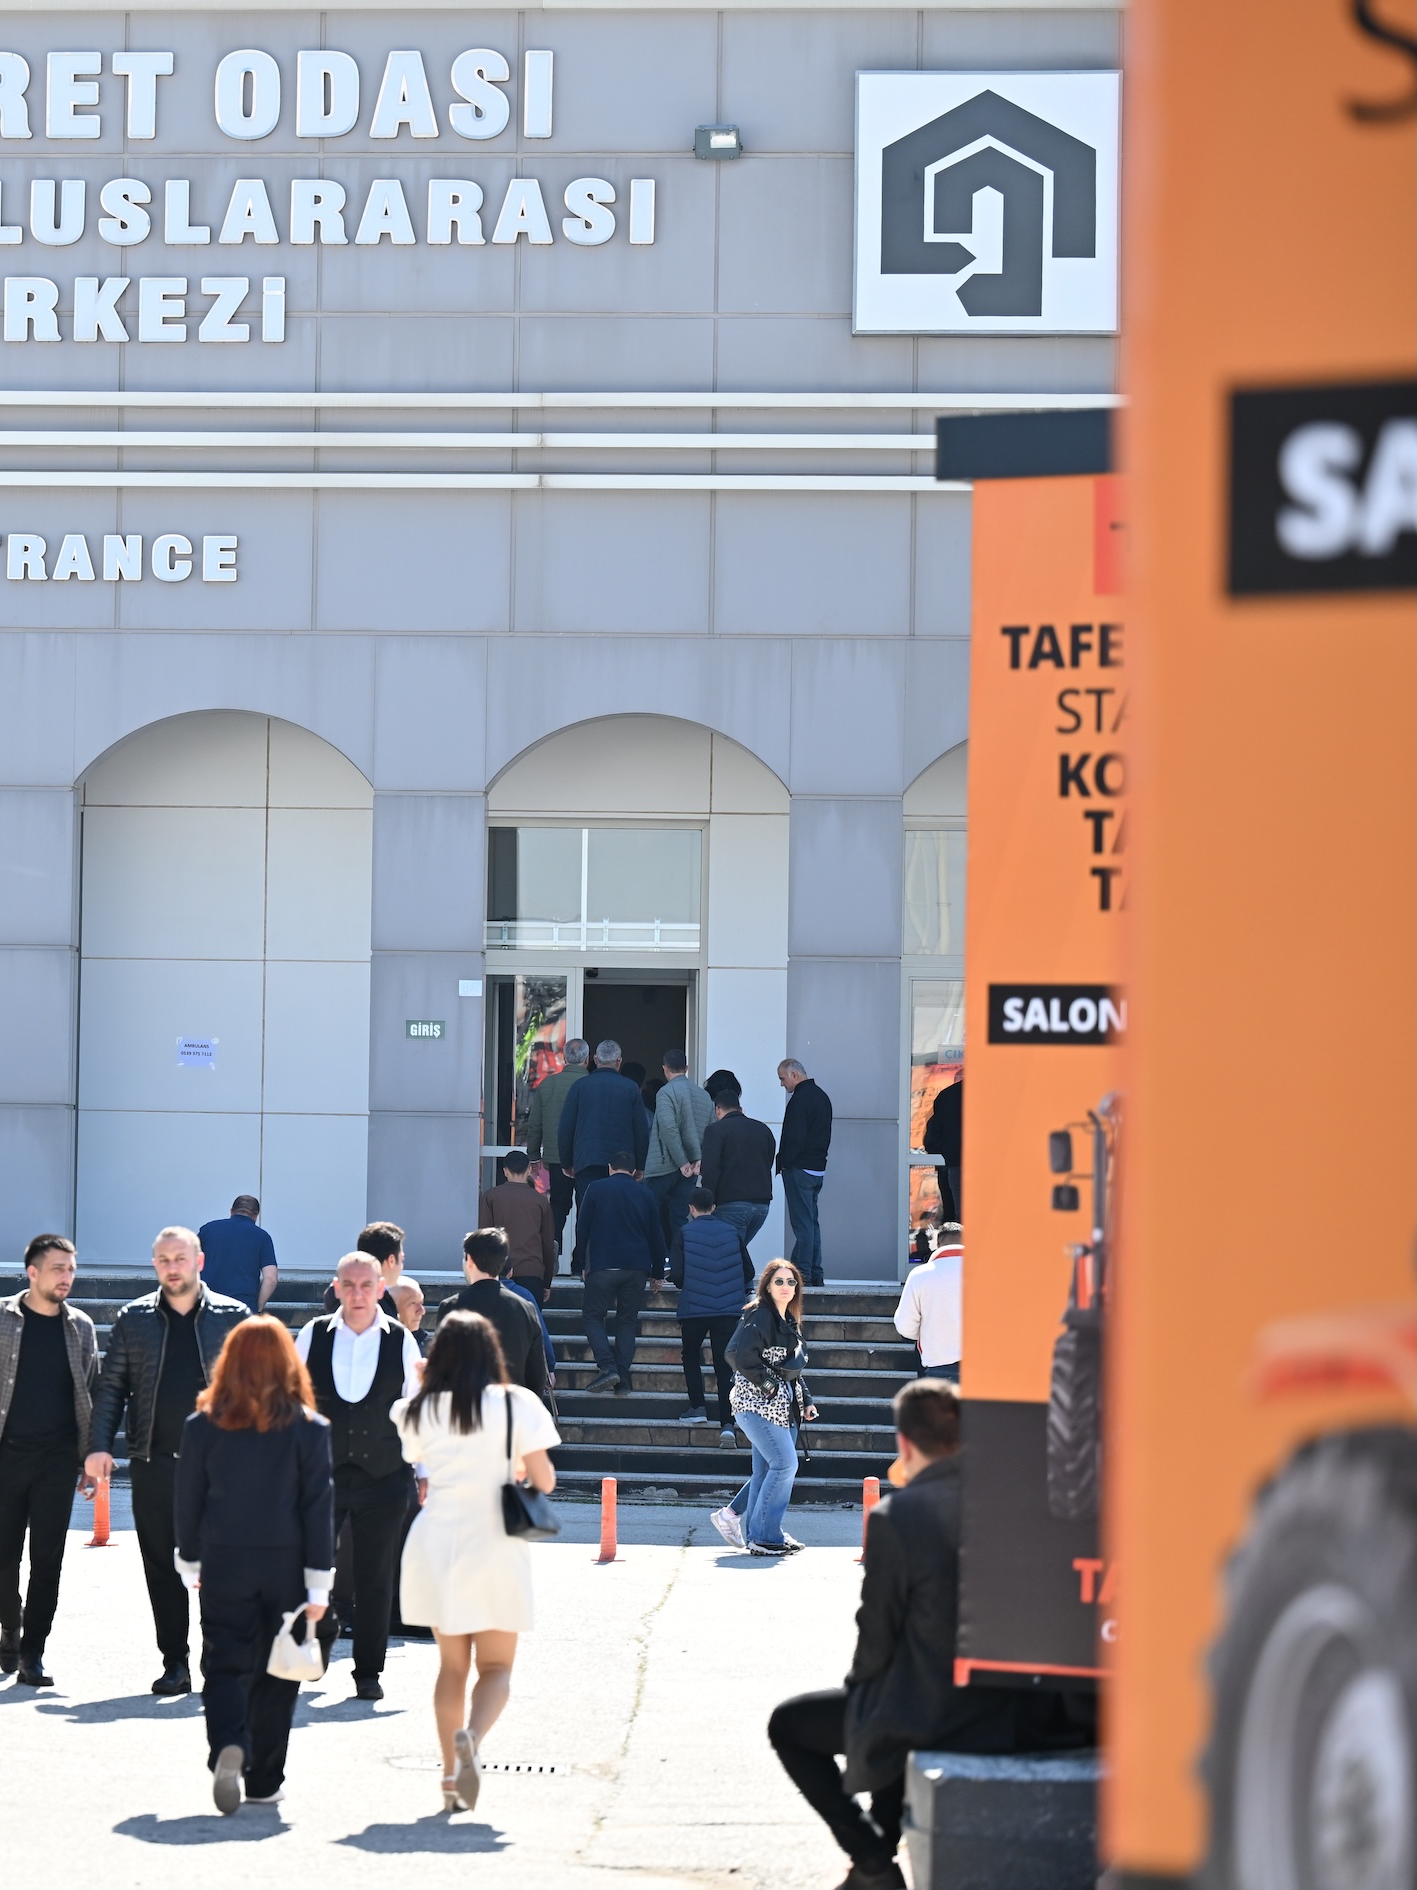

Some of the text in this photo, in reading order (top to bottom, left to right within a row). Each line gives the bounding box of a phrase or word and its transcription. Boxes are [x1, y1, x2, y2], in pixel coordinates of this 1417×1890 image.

[214, 48, 555, 141] ODASI
[410, 1021, 441, 1038] GİRİŞ
[1002, 996, 1128, 1034] SALON
